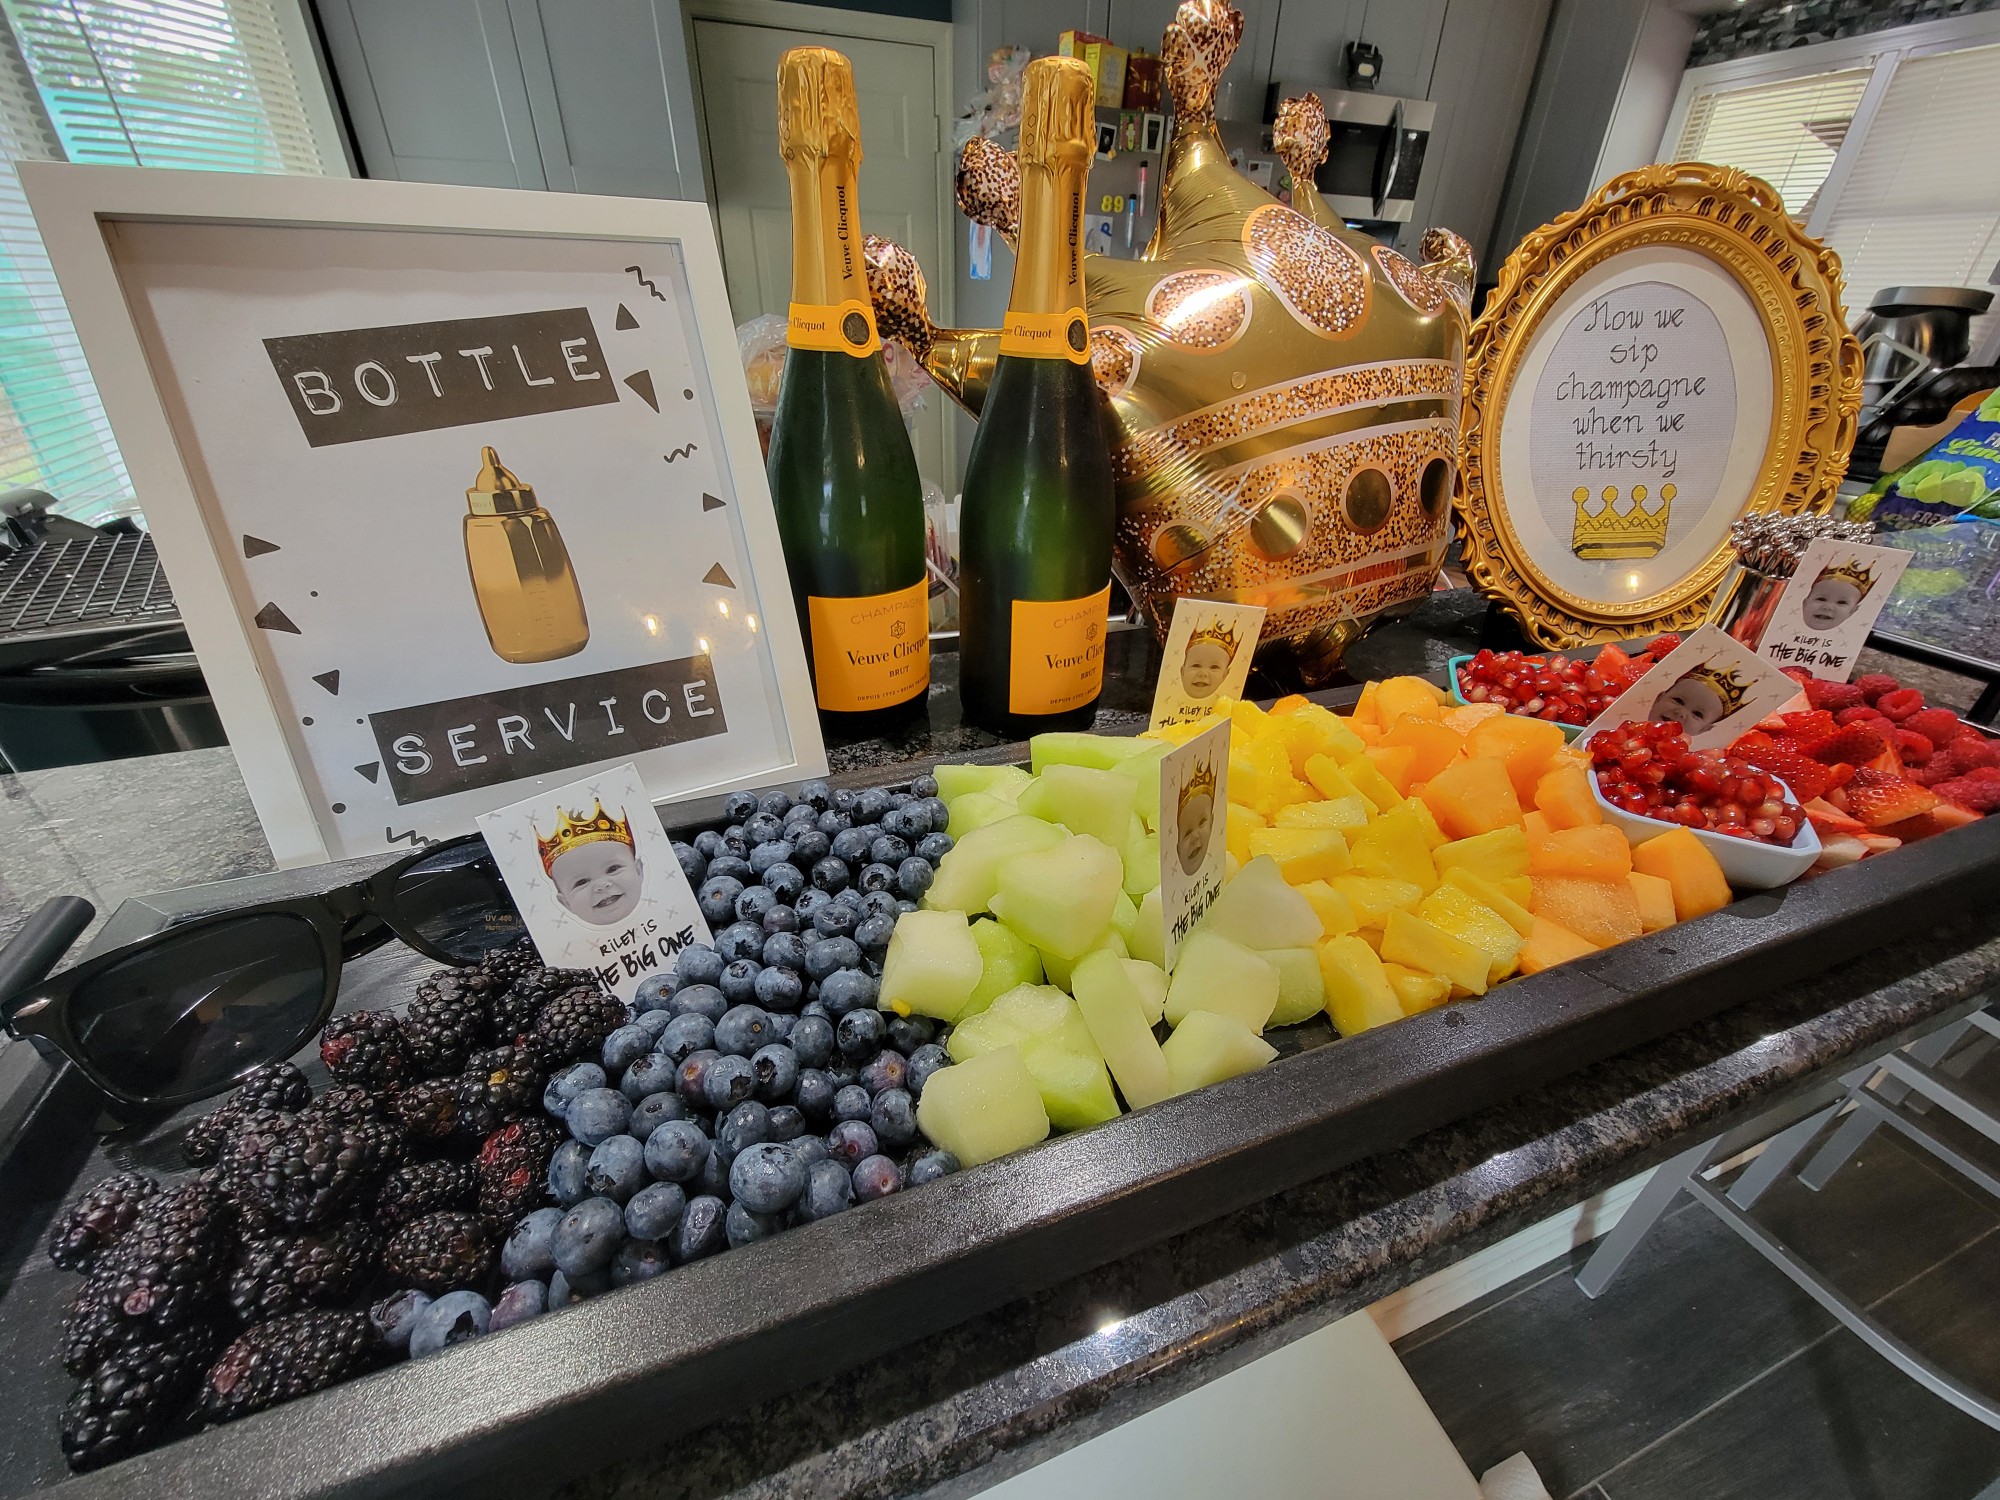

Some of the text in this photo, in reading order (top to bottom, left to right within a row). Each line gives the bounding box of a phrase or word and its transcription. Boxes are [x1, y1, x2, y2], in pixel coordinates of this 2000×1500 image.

[836, 184, 853, 281] Veuve Clicquot
[1068, 191, 1080, 287] Veuve Clicquot
[1013, 324, 1052, 340] Clicquot
[1583, 300, 1685, 332] Now we
[1610, 336, 1658, 373] sip
[293, 337, 601, 416] BOTTLE
[1556, 371, 1707, 409] champagne
[1572, 406, 1686, 435] when we
[1576, 439, 1678, 479] thirsty
[846, 650, 889, 667] Veuve
[889, 665, 910, 678] BRUT
[1044, 653, 1083, 670] Veuve
[1769, 642, 1797, 662] THE
[1819, 652, 1848, 668] ONE
[1080, 667, 1096, 680] BRUT
[391, 679, 715, 776] SERVICE
[485, 914, 497, 922] UV
[1171, 911, 1190, 945] THE
[1205, 879, 1222, 910] ONE
[658, 924, 696, 958] ONE
